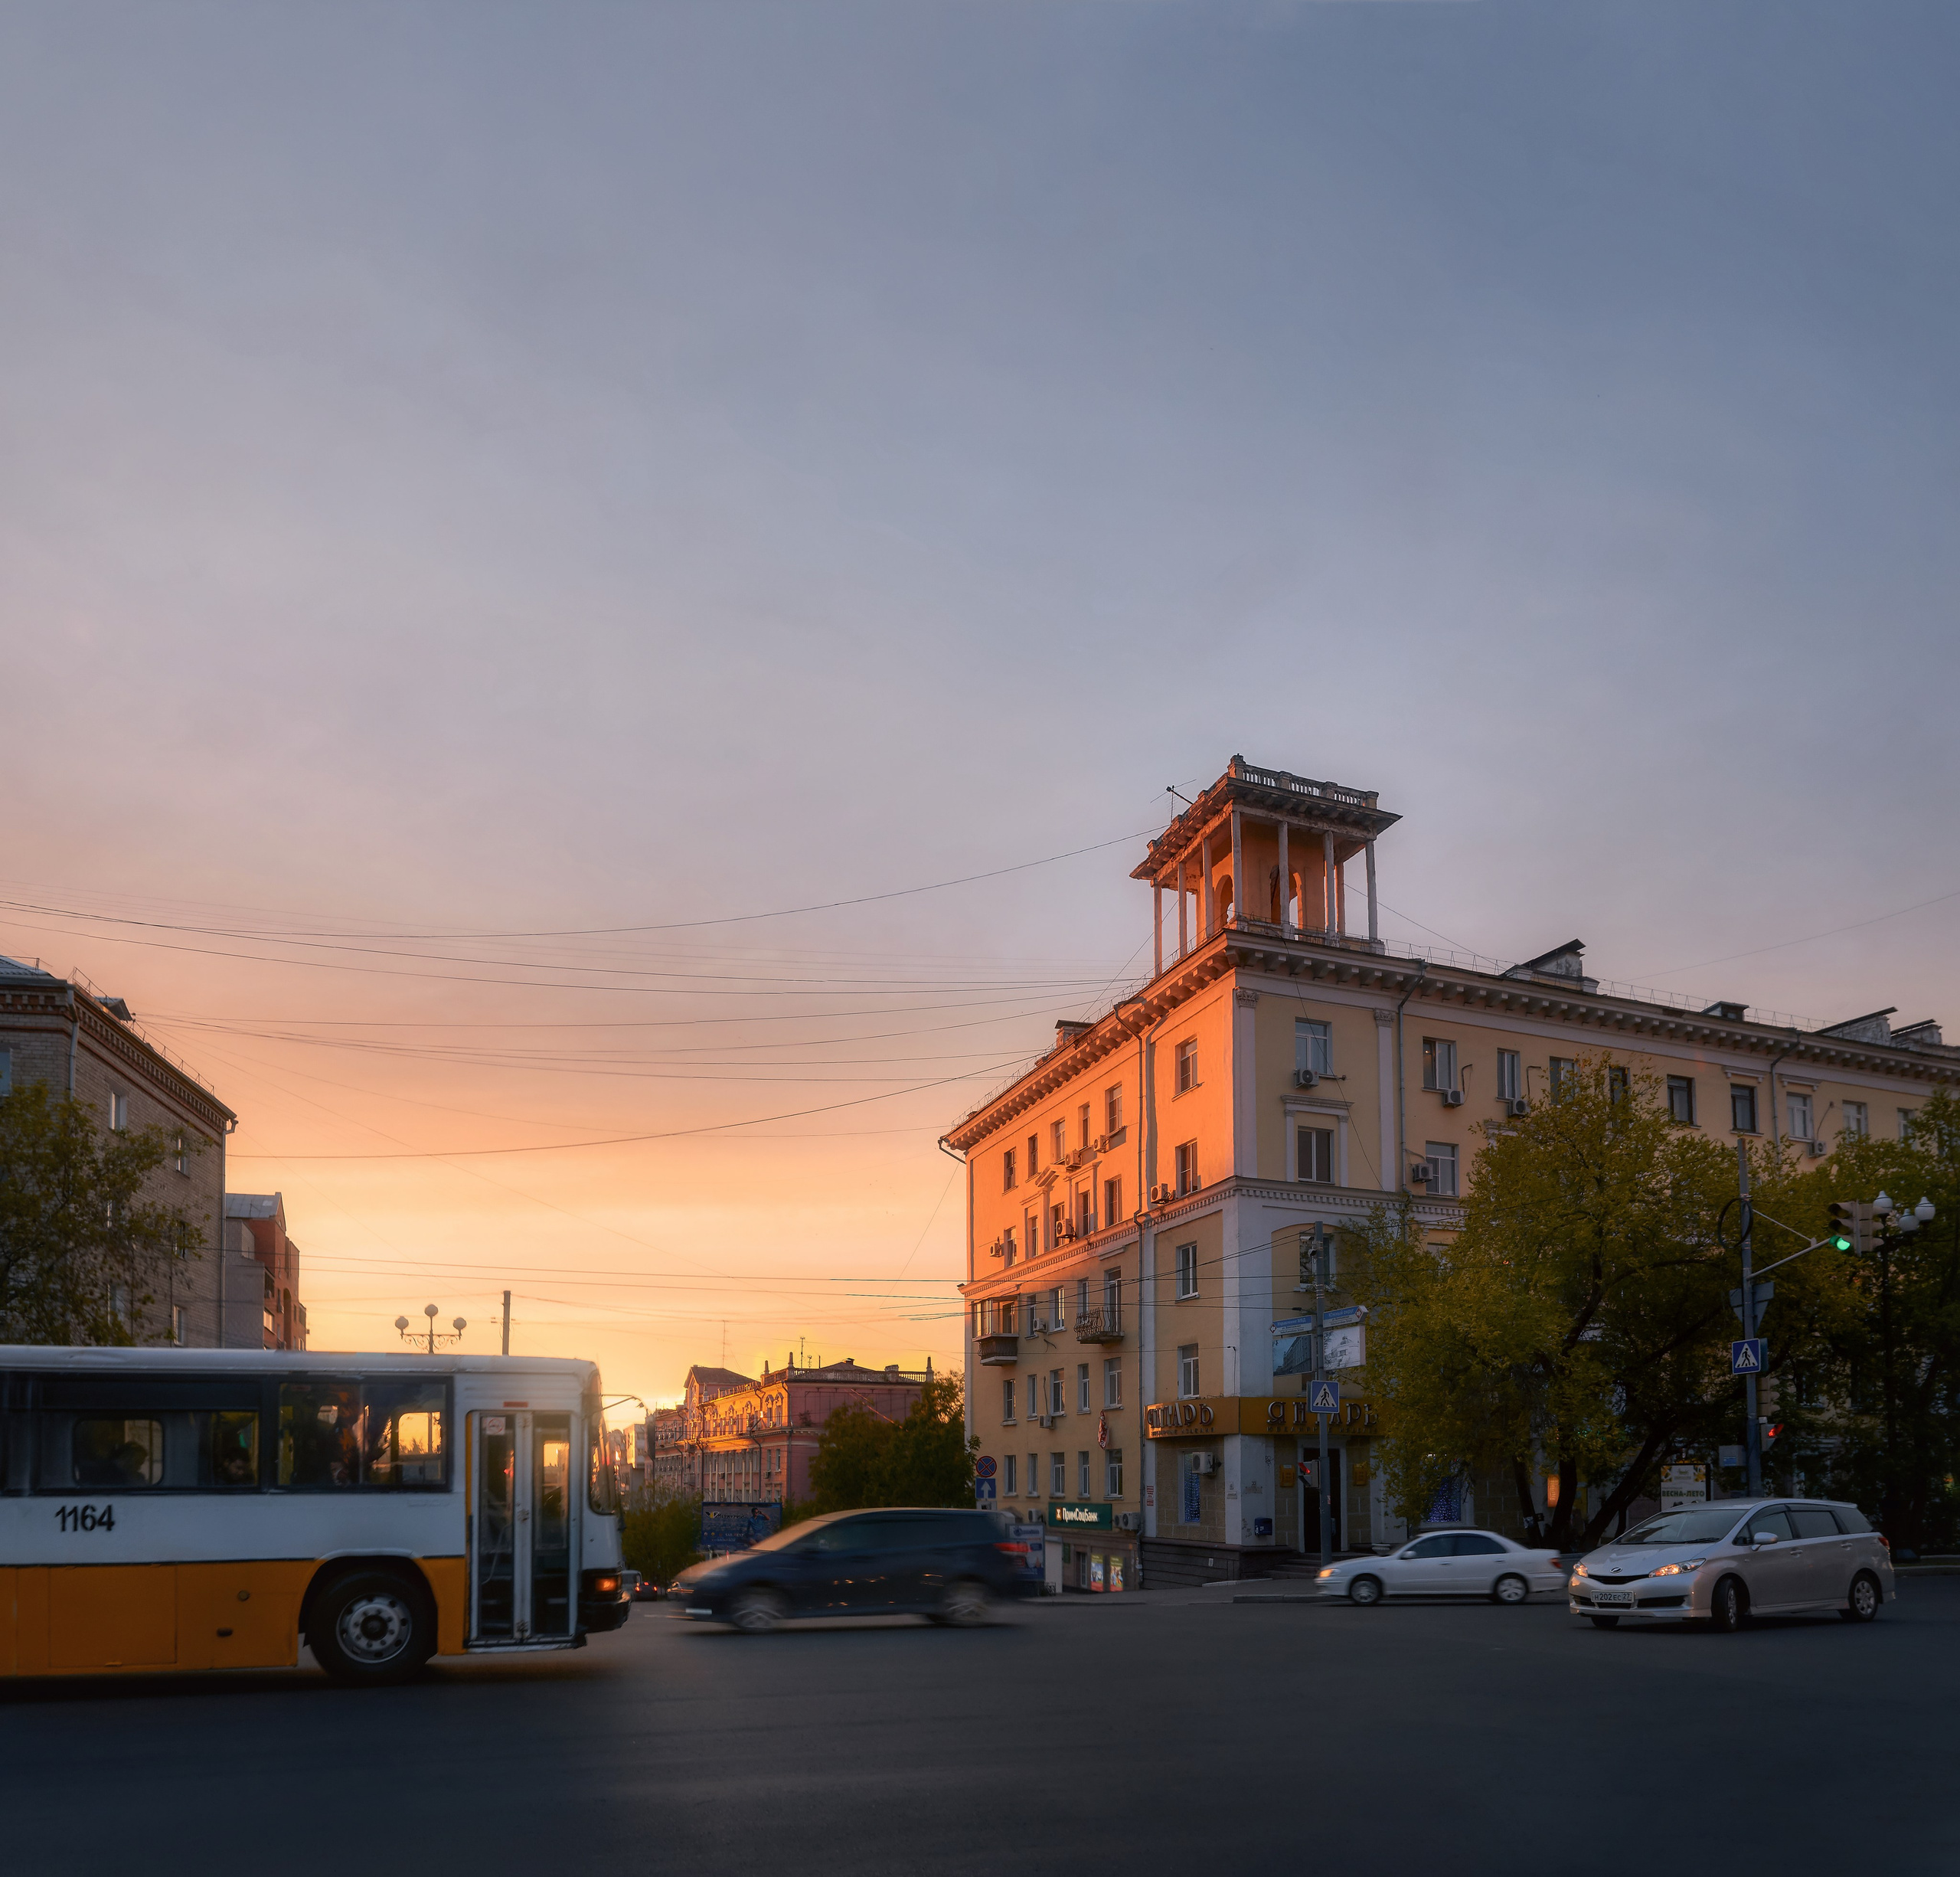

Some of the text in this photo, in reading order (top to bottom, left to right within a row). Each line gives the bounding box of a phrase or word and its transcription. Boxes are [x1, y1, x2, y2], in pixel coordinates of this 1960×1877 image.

[1266, 1401, 1379, 1427] ЯНАРЬ
[55, 1504, 116, 1532] 1164
[1062, 1506, 1098, 1523] ПримСоцБанк
